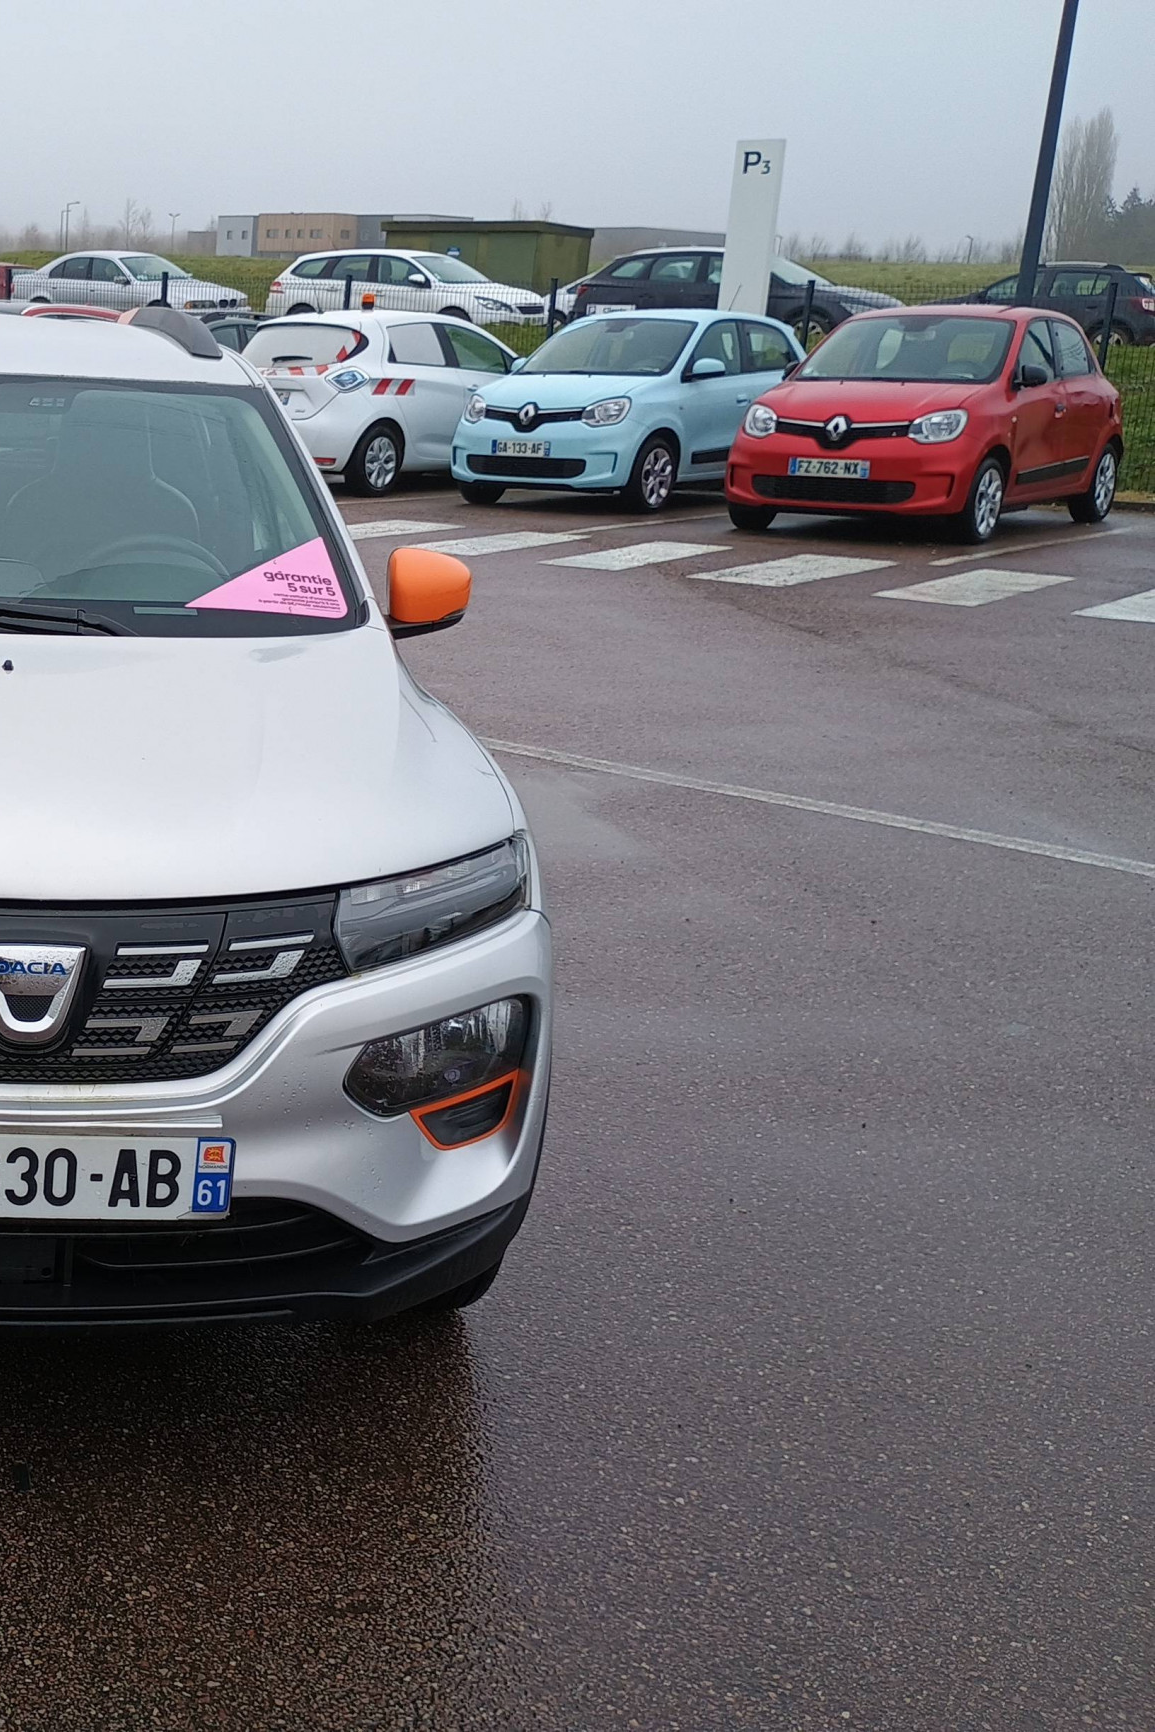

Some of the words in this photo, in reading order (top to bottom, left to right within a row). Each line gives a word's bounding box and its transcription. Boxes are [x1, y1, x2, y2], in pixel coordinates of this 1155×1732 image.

[497, 441, 543, 454] GA-133-AF
[797, 460, 860, 475] FZ-762-NX
[287, 582, 298, 593] 5
[299, 585, 324, 596] sur
[325, 586, 336, 597] 5
[197, 1179, 227, 1206] 61
